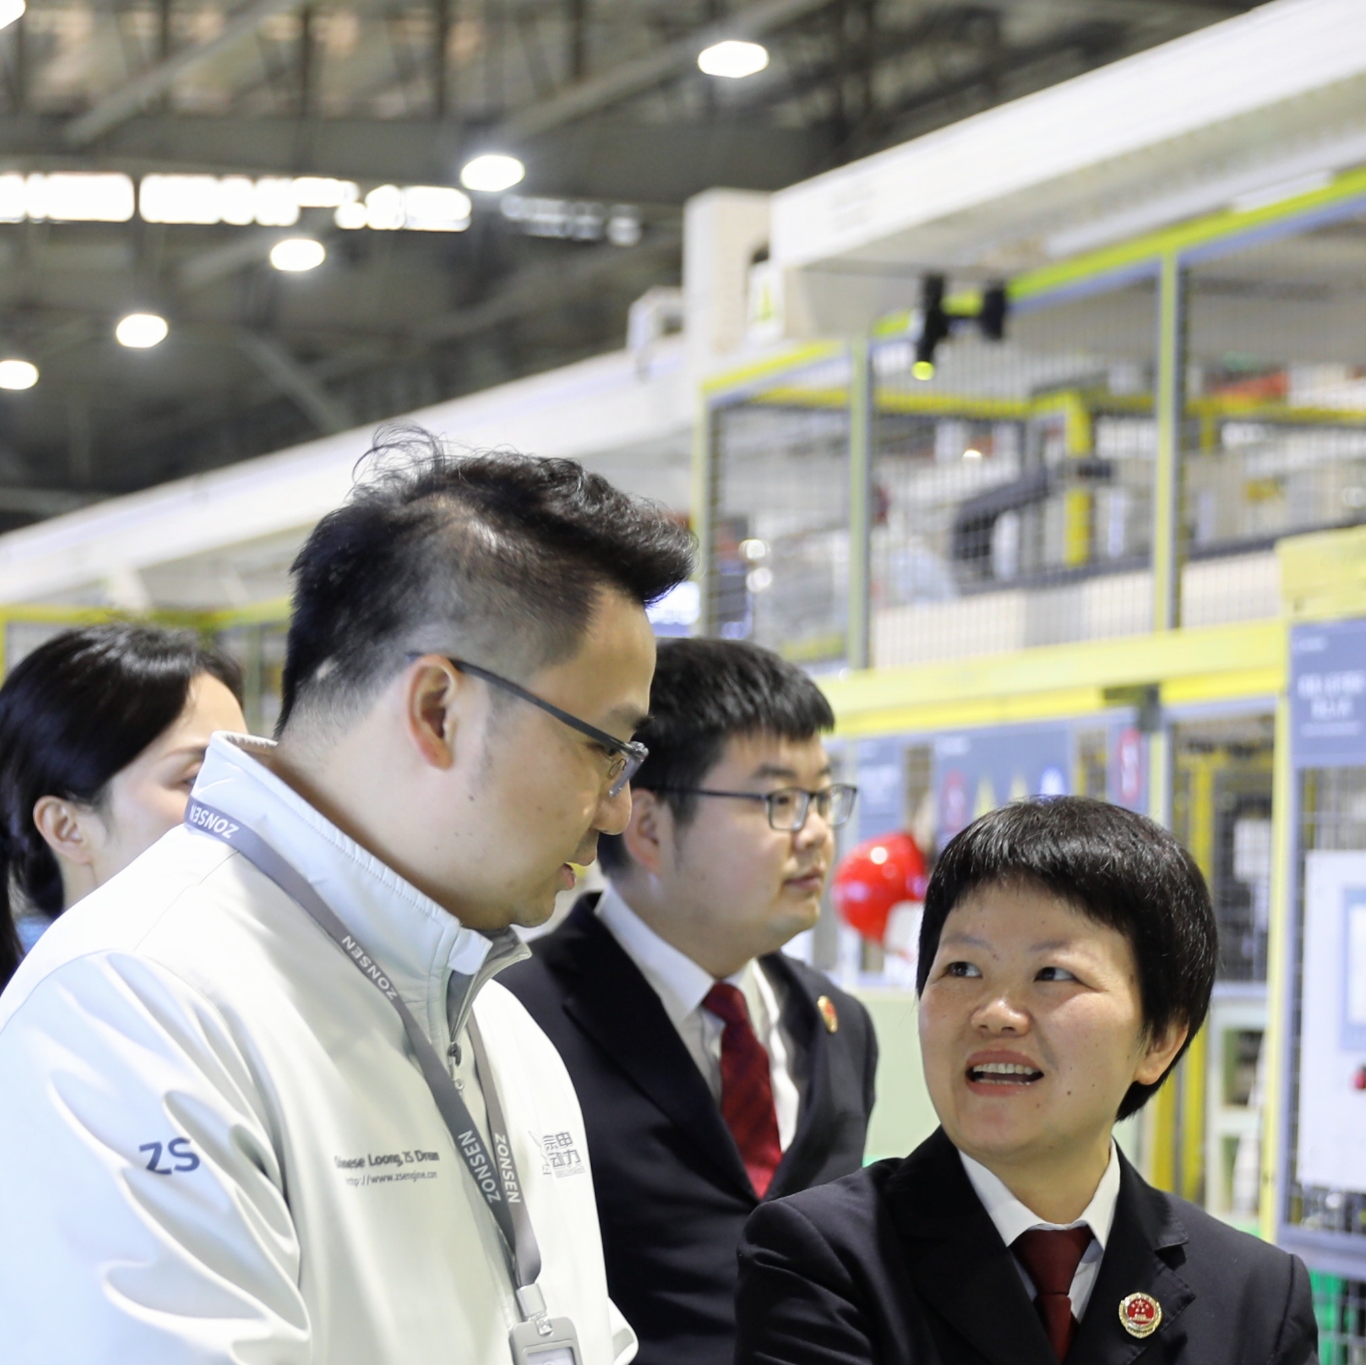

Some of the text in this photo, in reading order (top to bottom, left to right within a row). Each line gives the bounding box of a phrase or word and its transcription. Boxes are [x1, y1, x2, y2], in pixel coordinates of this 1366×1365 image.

[189, 804, 240, 839] ZONSEN
[341, 935, 398, 1000] ZONSEN
[138, 1136, 201, 1175] ZS
[457, 1130, 502, 1204] ZONSEN
[494, 1132, 522, 1204] ZONSEN
